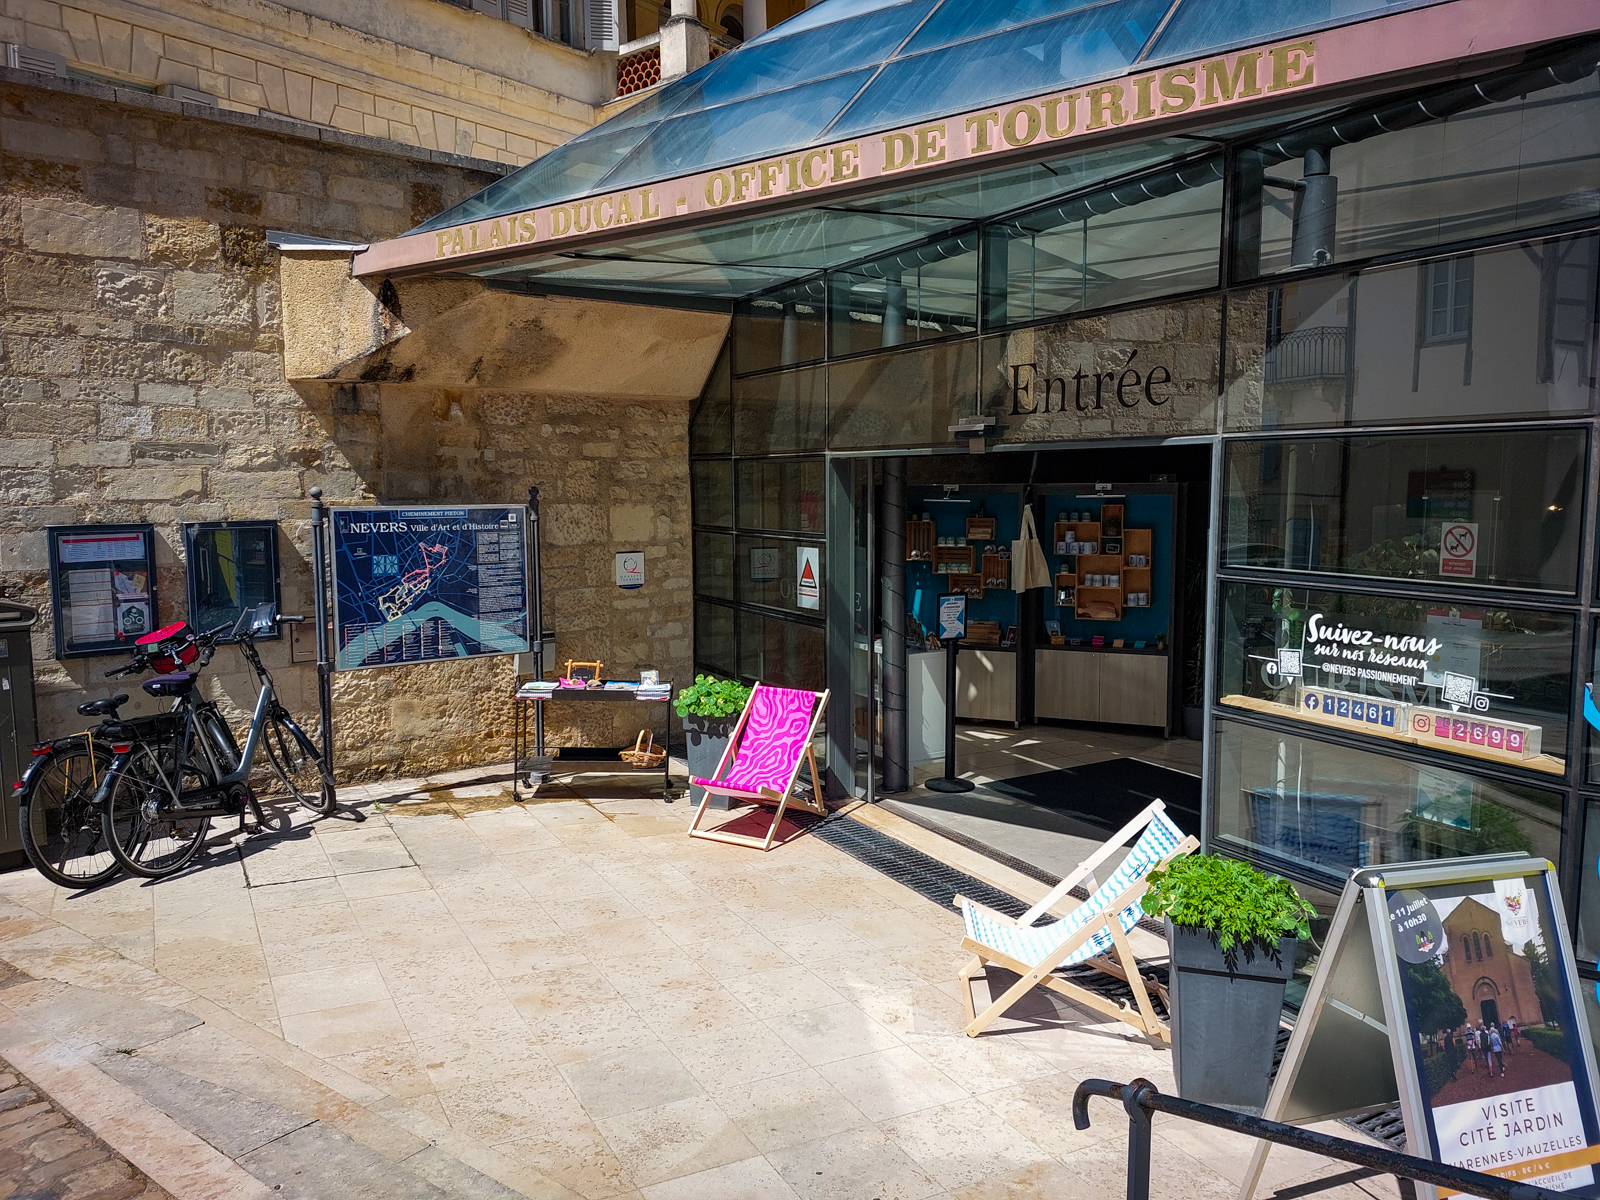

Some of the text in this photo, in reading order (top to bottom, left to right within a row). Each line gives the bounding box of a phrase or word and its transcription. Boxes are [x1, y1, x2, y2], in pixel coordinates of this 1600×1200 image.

[436, 211, 537, 259] PALAIS
[551, 188, 660, 238] DUCAL
[704, 143, 860, 208] OFFICE
[881, 122, 947, 172] DE
[965, 39, 1316, 154] TOURISME
[1008, 349, 1172, 416] Entrée
[349, 521, 408, 534] NEVERS
[410, 524, 429, 532] Ville
[430, 523, 451, 531] d'Art
[462, 522, 499, 531] d'Histoire
[1306, 613, 1442, 657] Suivez-nous
[1314, 643, 1429, 670] sur nos réseaux
[1322, 662, 1418, 686] @NEVERS PASSIONNEMENT
[1389, 897, 1428, 922] e 11 Juillet
[1397, 913, 1427, 933] à 10h30
[1481, 1097, 1536, 1121] VISITE
[1459, 1112, 1564, 1146] CITÉ JARDIN
[1563, 1172, 1573, 1180] DE
